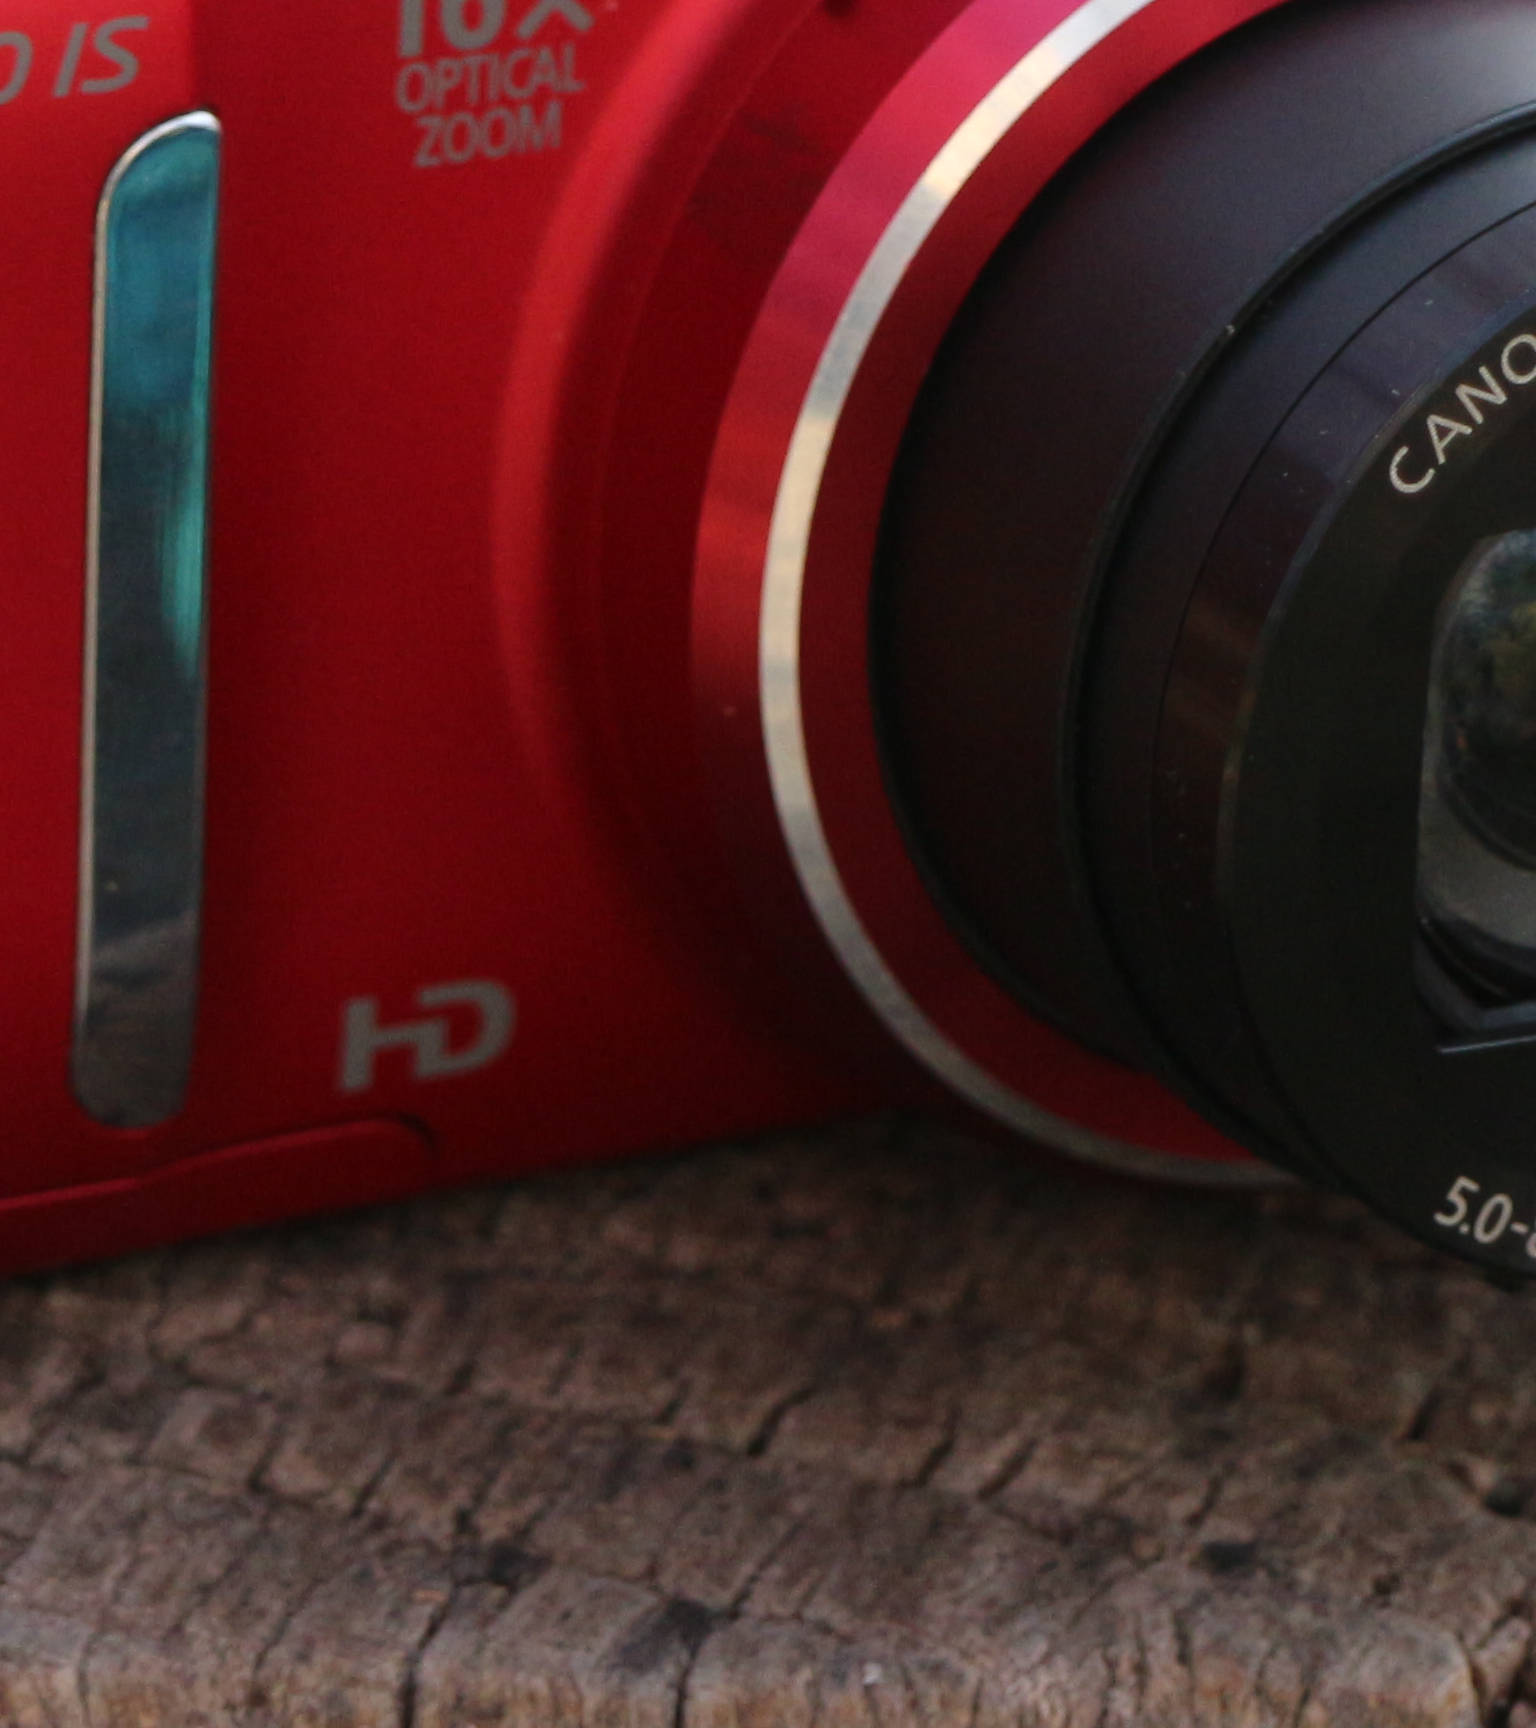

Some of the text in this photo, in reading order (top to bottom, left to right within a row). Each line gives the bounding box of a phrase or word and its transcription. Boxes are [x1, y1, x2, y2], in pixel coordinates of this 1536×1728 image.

[53, 15, 151, 98] IS
[394, 41, 586, 113] OPTICAL
[413, 100, 563, 168] ZOOM
[340, 978, 515, 1094] HD
